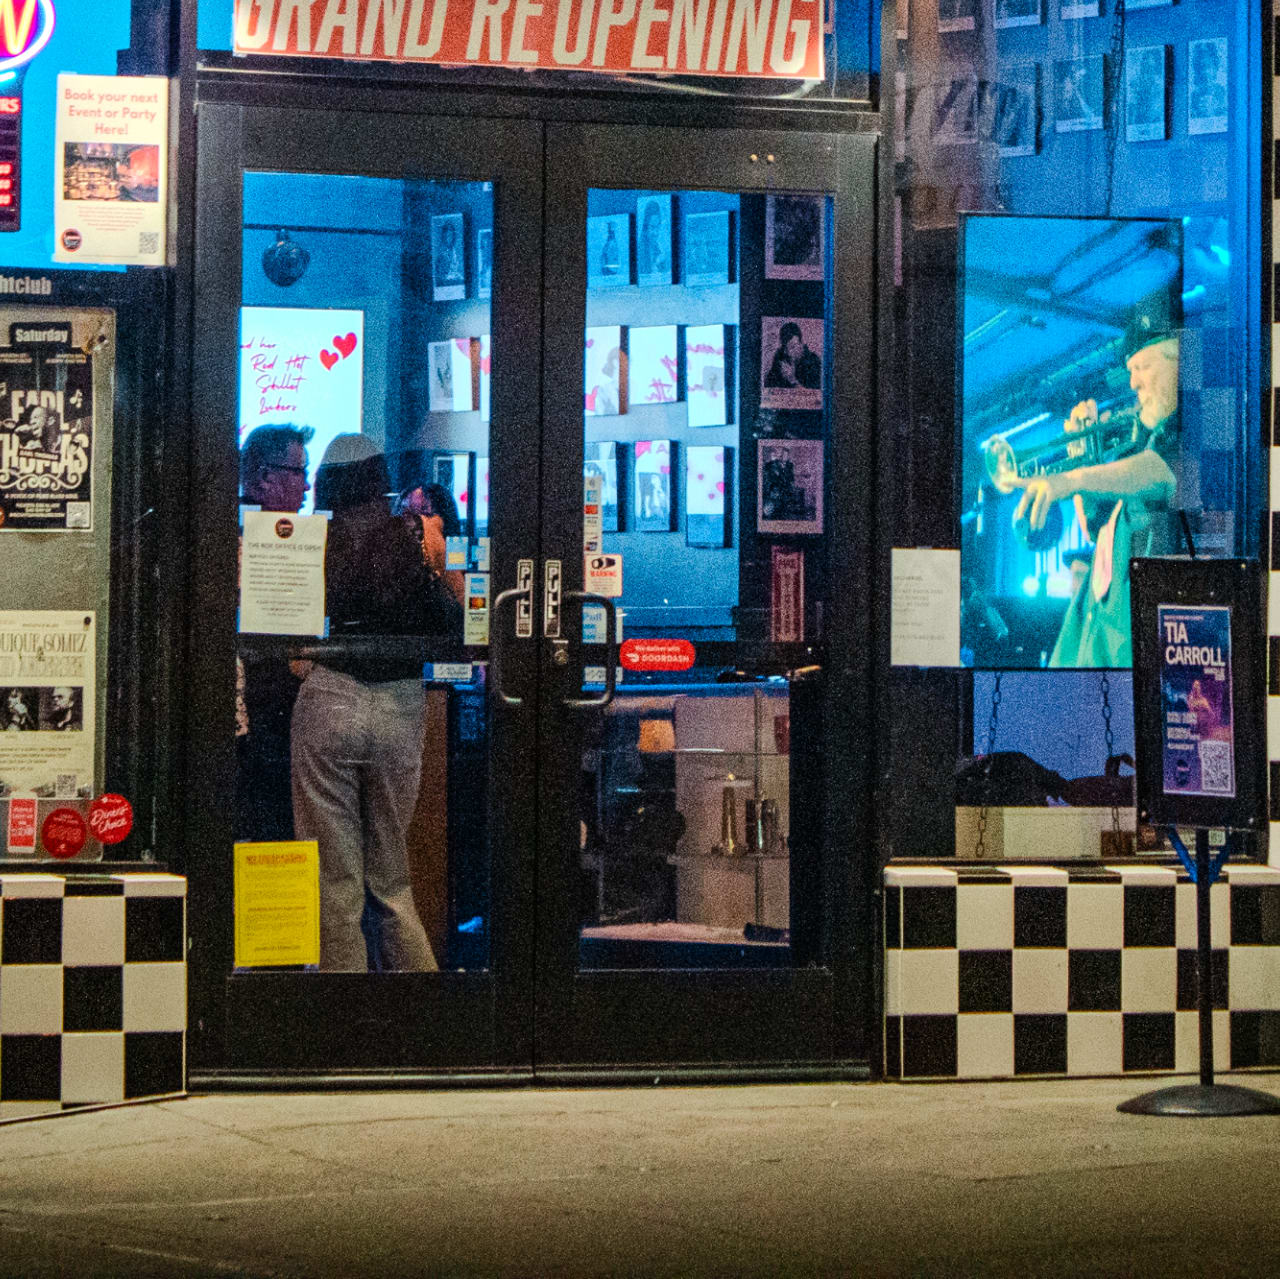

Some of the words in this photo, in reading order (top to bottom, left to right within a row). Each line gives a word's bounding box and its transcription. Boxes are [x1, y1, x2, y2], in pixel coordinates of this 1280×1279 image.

[64, 88, 94, 101] Book
[97, 92, 127, 104] your
[130, 93, 158, 104] next
[68, 105, 102, 118] Event
[105, 109, 119, 119] or
[122, 107, 157, 122] Party
[94, 123, 129, 136] Here!
[16, 328, 69, 343] Saturday
[519, 568, 531, 619] PULL
[546, 568, 559, 619] PULL
[1163, 621, 1189, 644] TIA
[641, 654, 690, 664] DOORDASH
[1165, 645, 1226, 667] CARROLL
